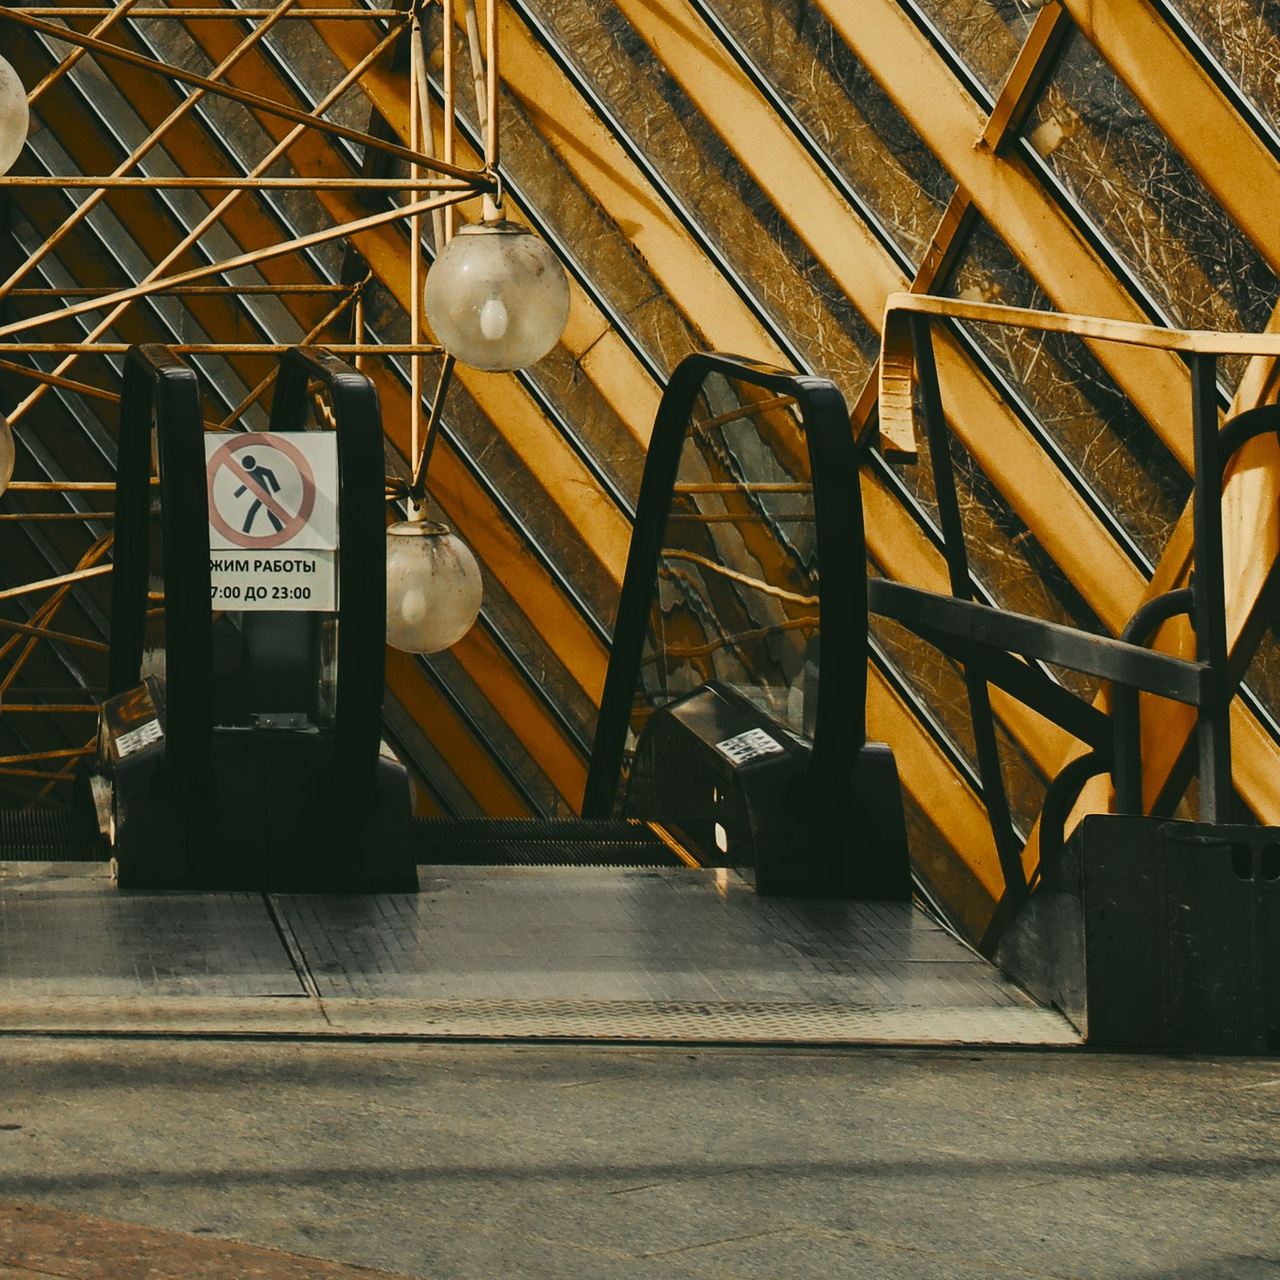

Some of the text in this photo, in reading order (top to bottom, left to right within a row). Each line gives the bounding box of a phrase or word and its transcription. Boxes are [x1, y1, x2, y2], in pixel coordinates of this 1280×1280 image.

[209, 559, 316, 573] ЖИМ РАБОТЫ
[211, 586, 311, 601] 7:00 ДО 23:00
